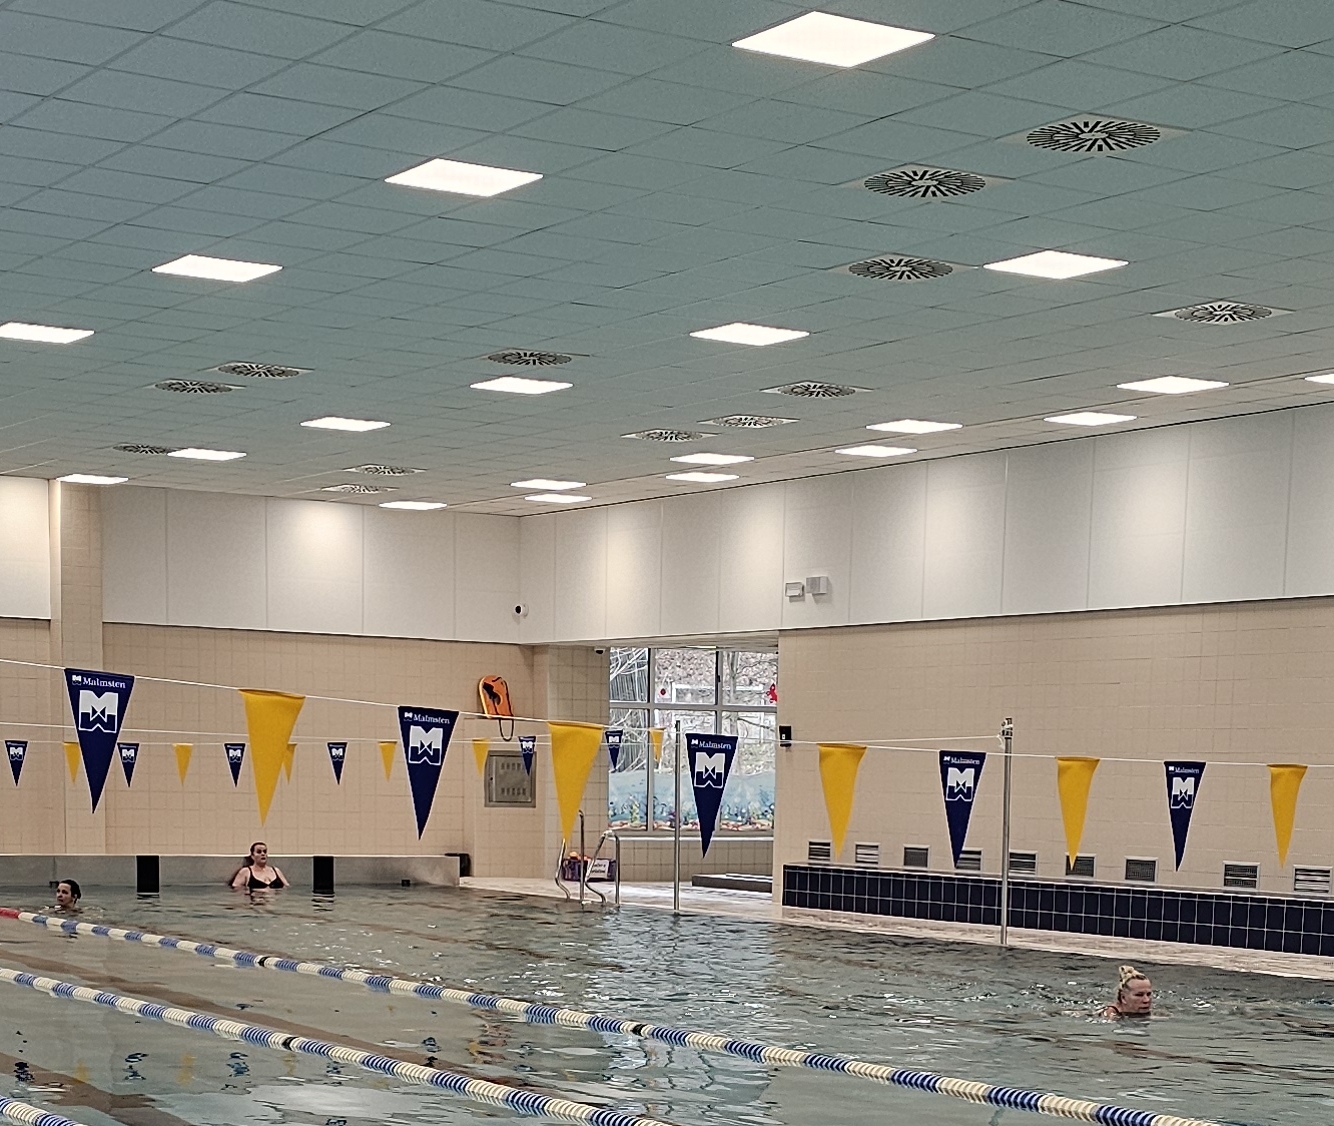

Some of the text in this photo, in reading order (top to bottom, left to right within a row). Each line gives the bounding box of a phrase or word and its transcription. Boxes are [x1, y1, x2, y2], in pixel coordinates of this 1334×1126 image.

[83, 677, 126, 689] Malmsten
[413, 713, 450, 724] Malmsten
[698, 740, 732, 750] Malmsten
